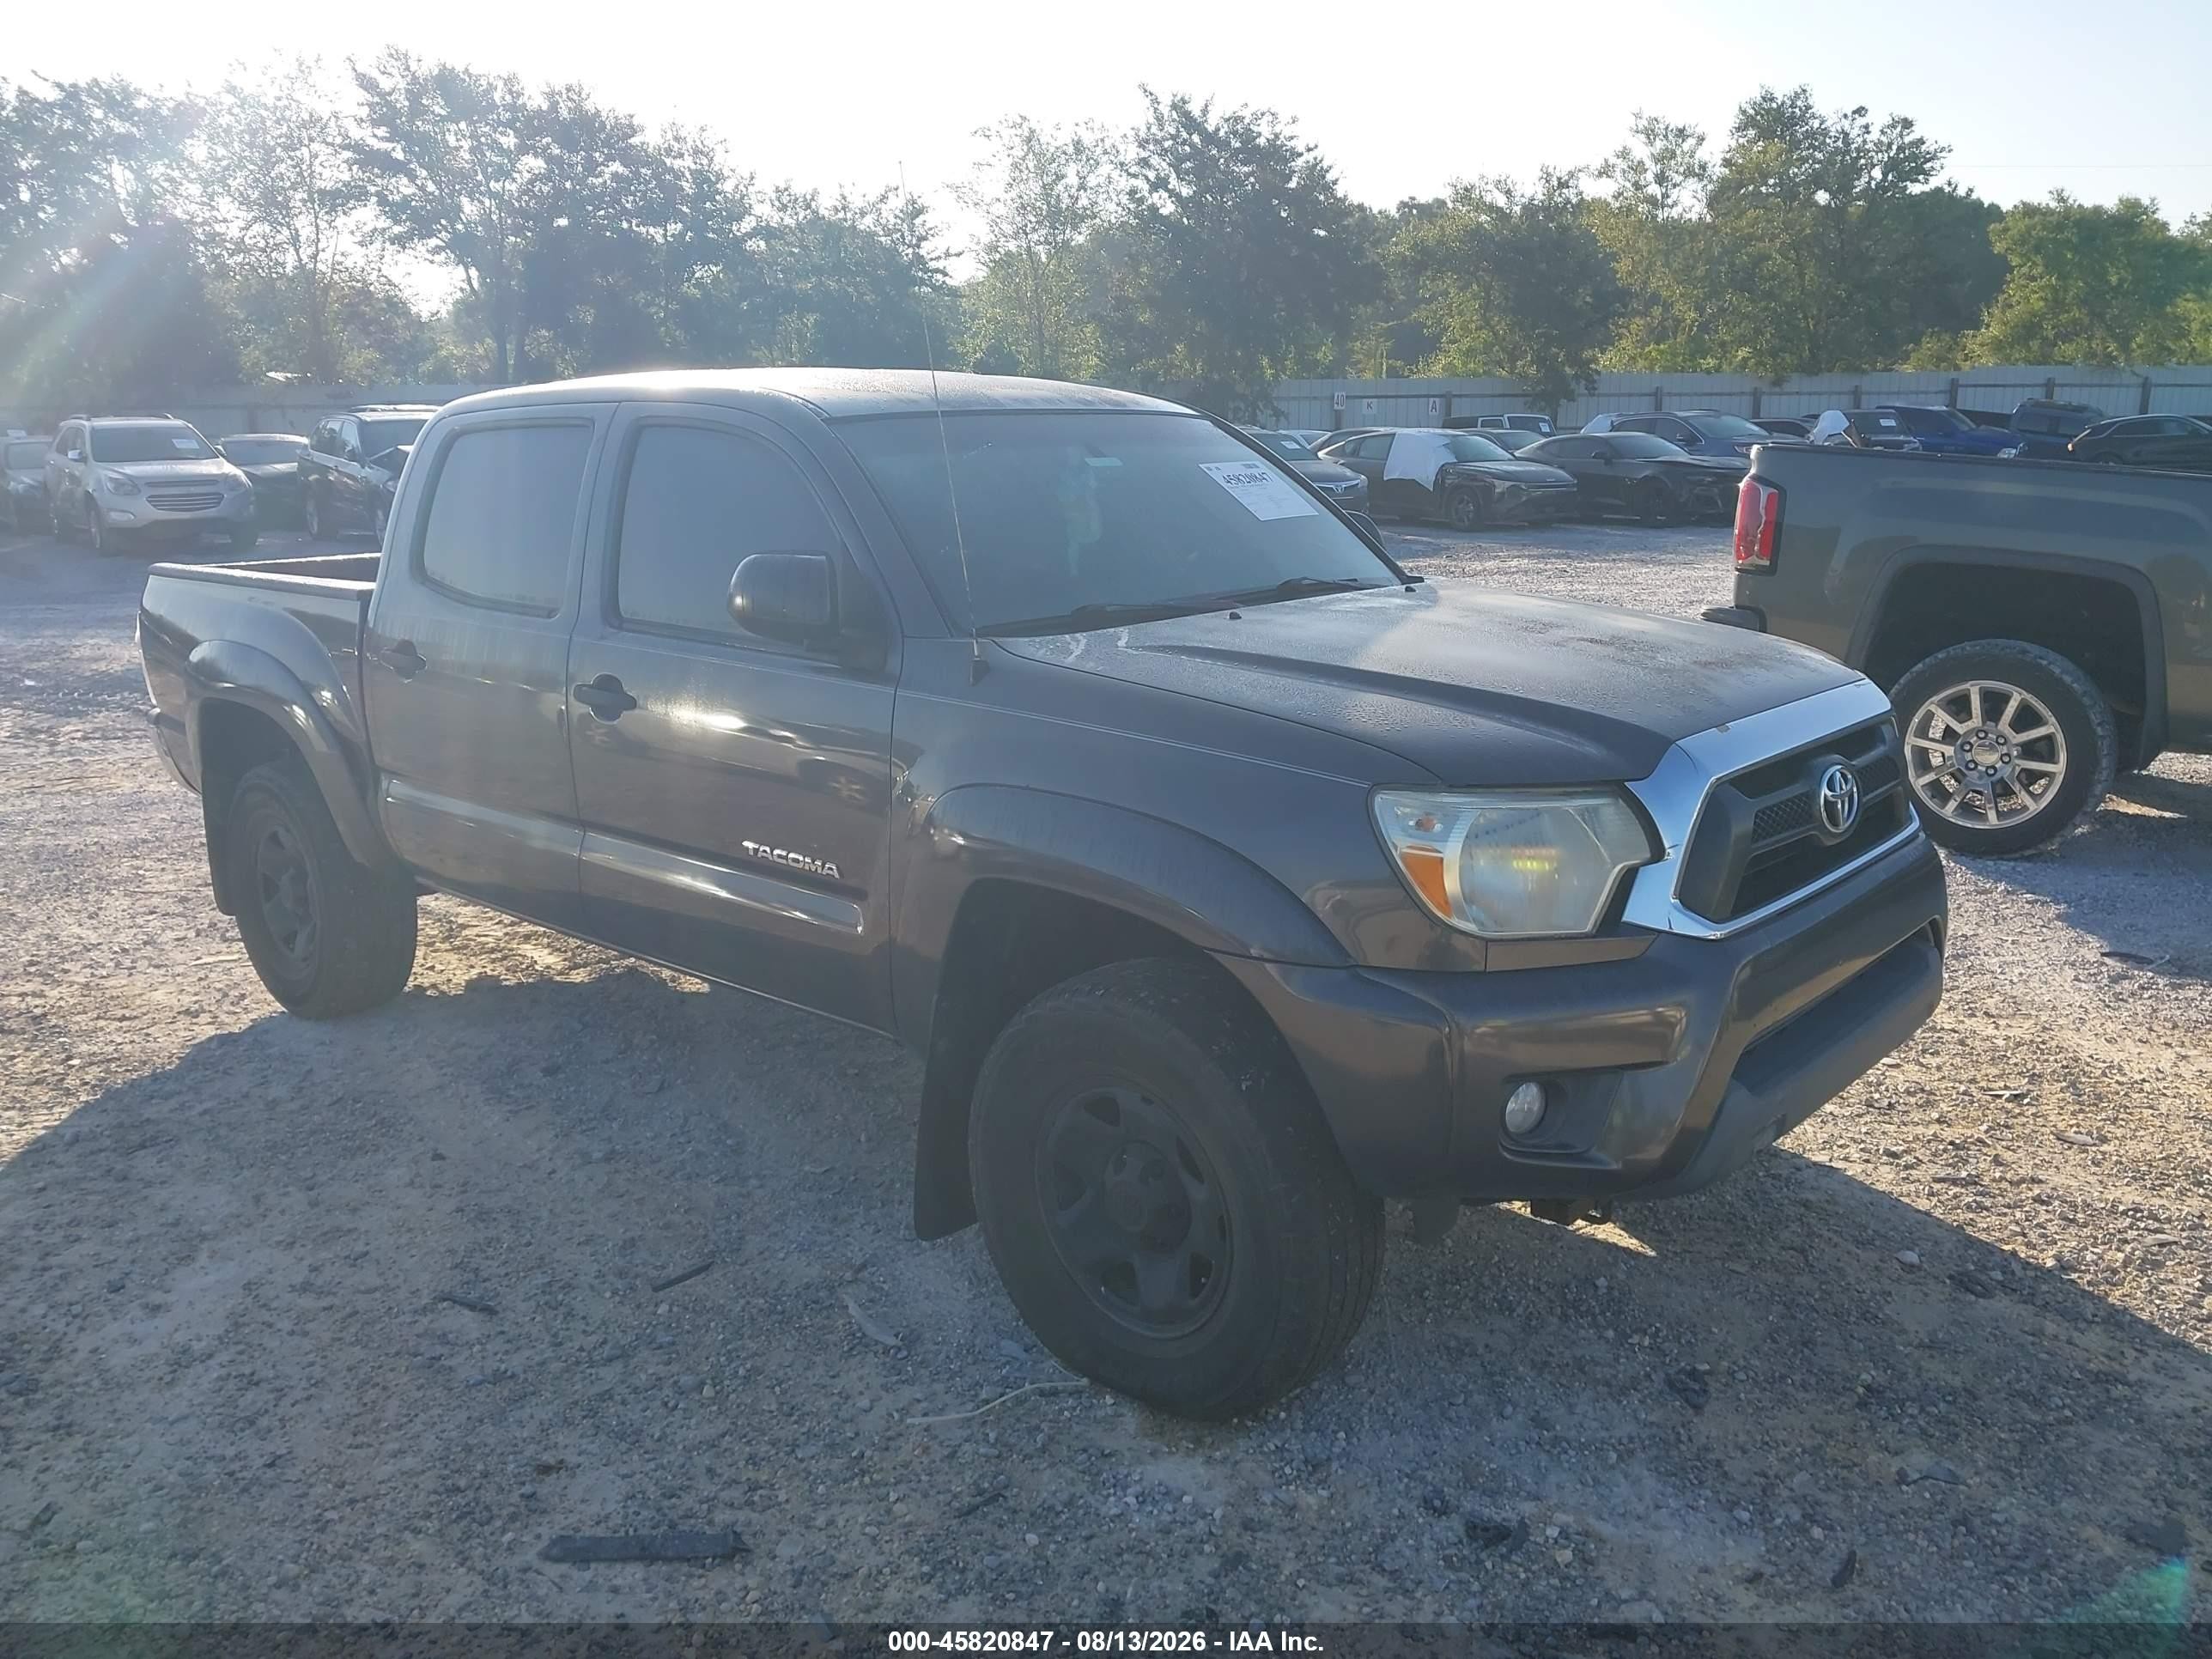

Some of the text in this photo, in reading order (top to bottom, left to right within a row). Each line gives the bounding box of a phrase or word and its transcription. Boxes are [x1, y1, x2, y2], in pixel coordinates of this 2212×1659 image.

[1334, 394, 1345, 408] 40
[1367, 401, 1373, 410] K
[1431, 400, 1437, 412] A
[1222, 471, 1272, 485] 45820847
[742, 841, 840, 878] TACOMA
